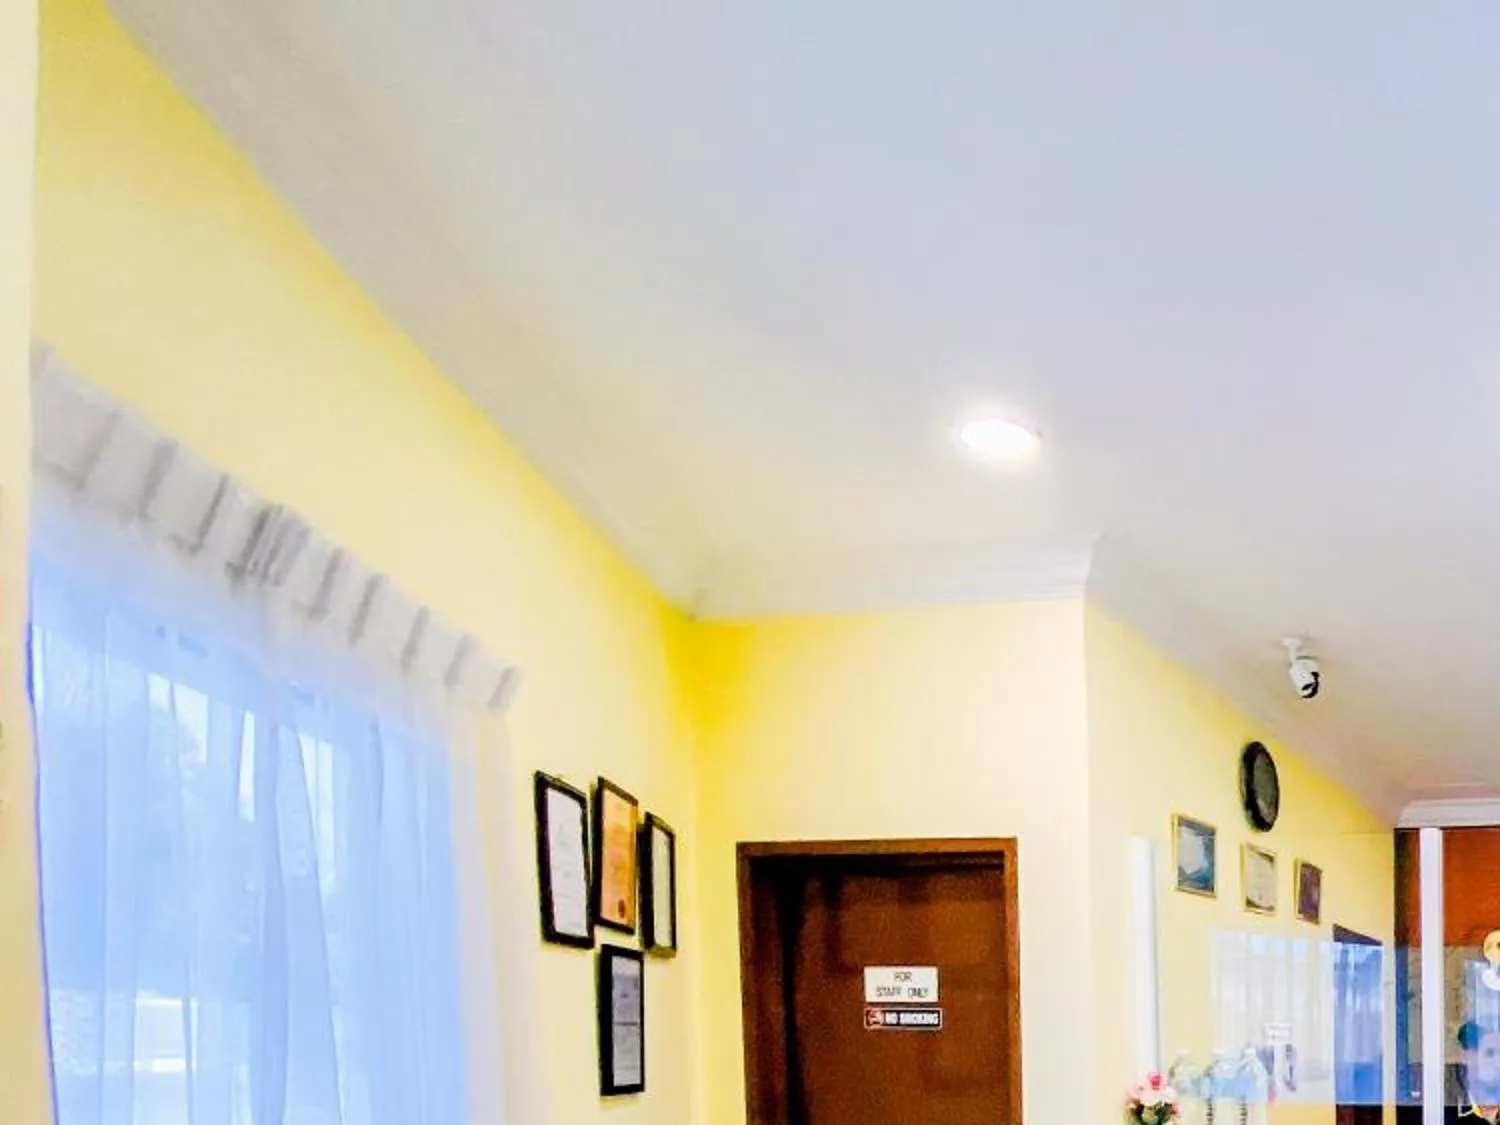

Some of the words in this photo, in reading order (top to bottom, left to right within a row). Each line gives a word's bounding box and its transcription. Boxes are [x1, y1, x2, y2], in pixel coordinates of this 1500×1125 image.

[893, 971, 913, 982] FOR
[876, 986, 902, 997] STAFF
[906, 986, 929, 998] ONLY
